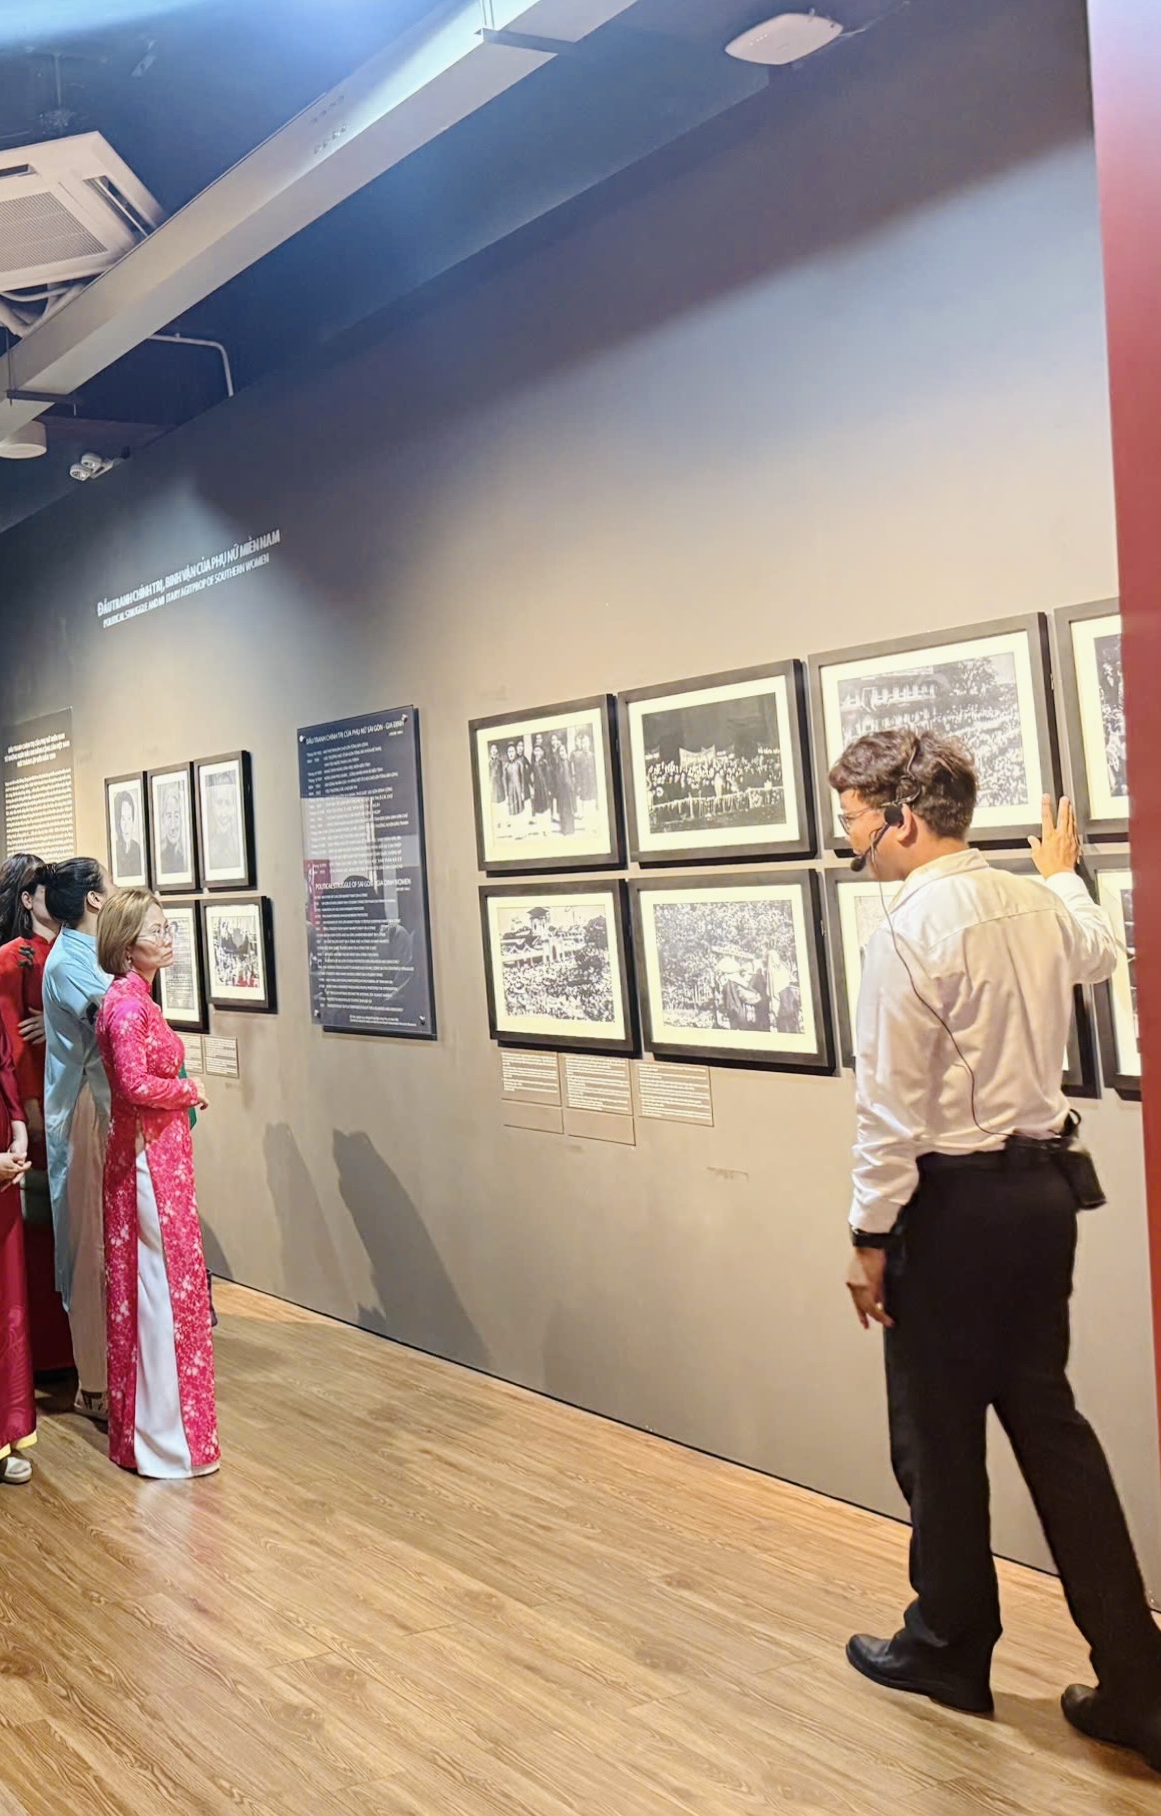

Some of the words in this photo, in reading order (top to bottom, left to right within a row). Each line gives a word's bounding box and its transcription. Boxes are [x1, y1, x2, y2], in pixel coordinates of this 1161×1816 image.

[196, 556, 211, 575] CỦA
[211, 550, 227, 568] PHỤ
[227, 543, 239, 564] NỮ
[259, 528, 280, 550] NAM
[206, 574, 215, 587] OF
[214, 563, 245, 584] SOUTHERN
[244, 552, 269, 572] WOMEN
